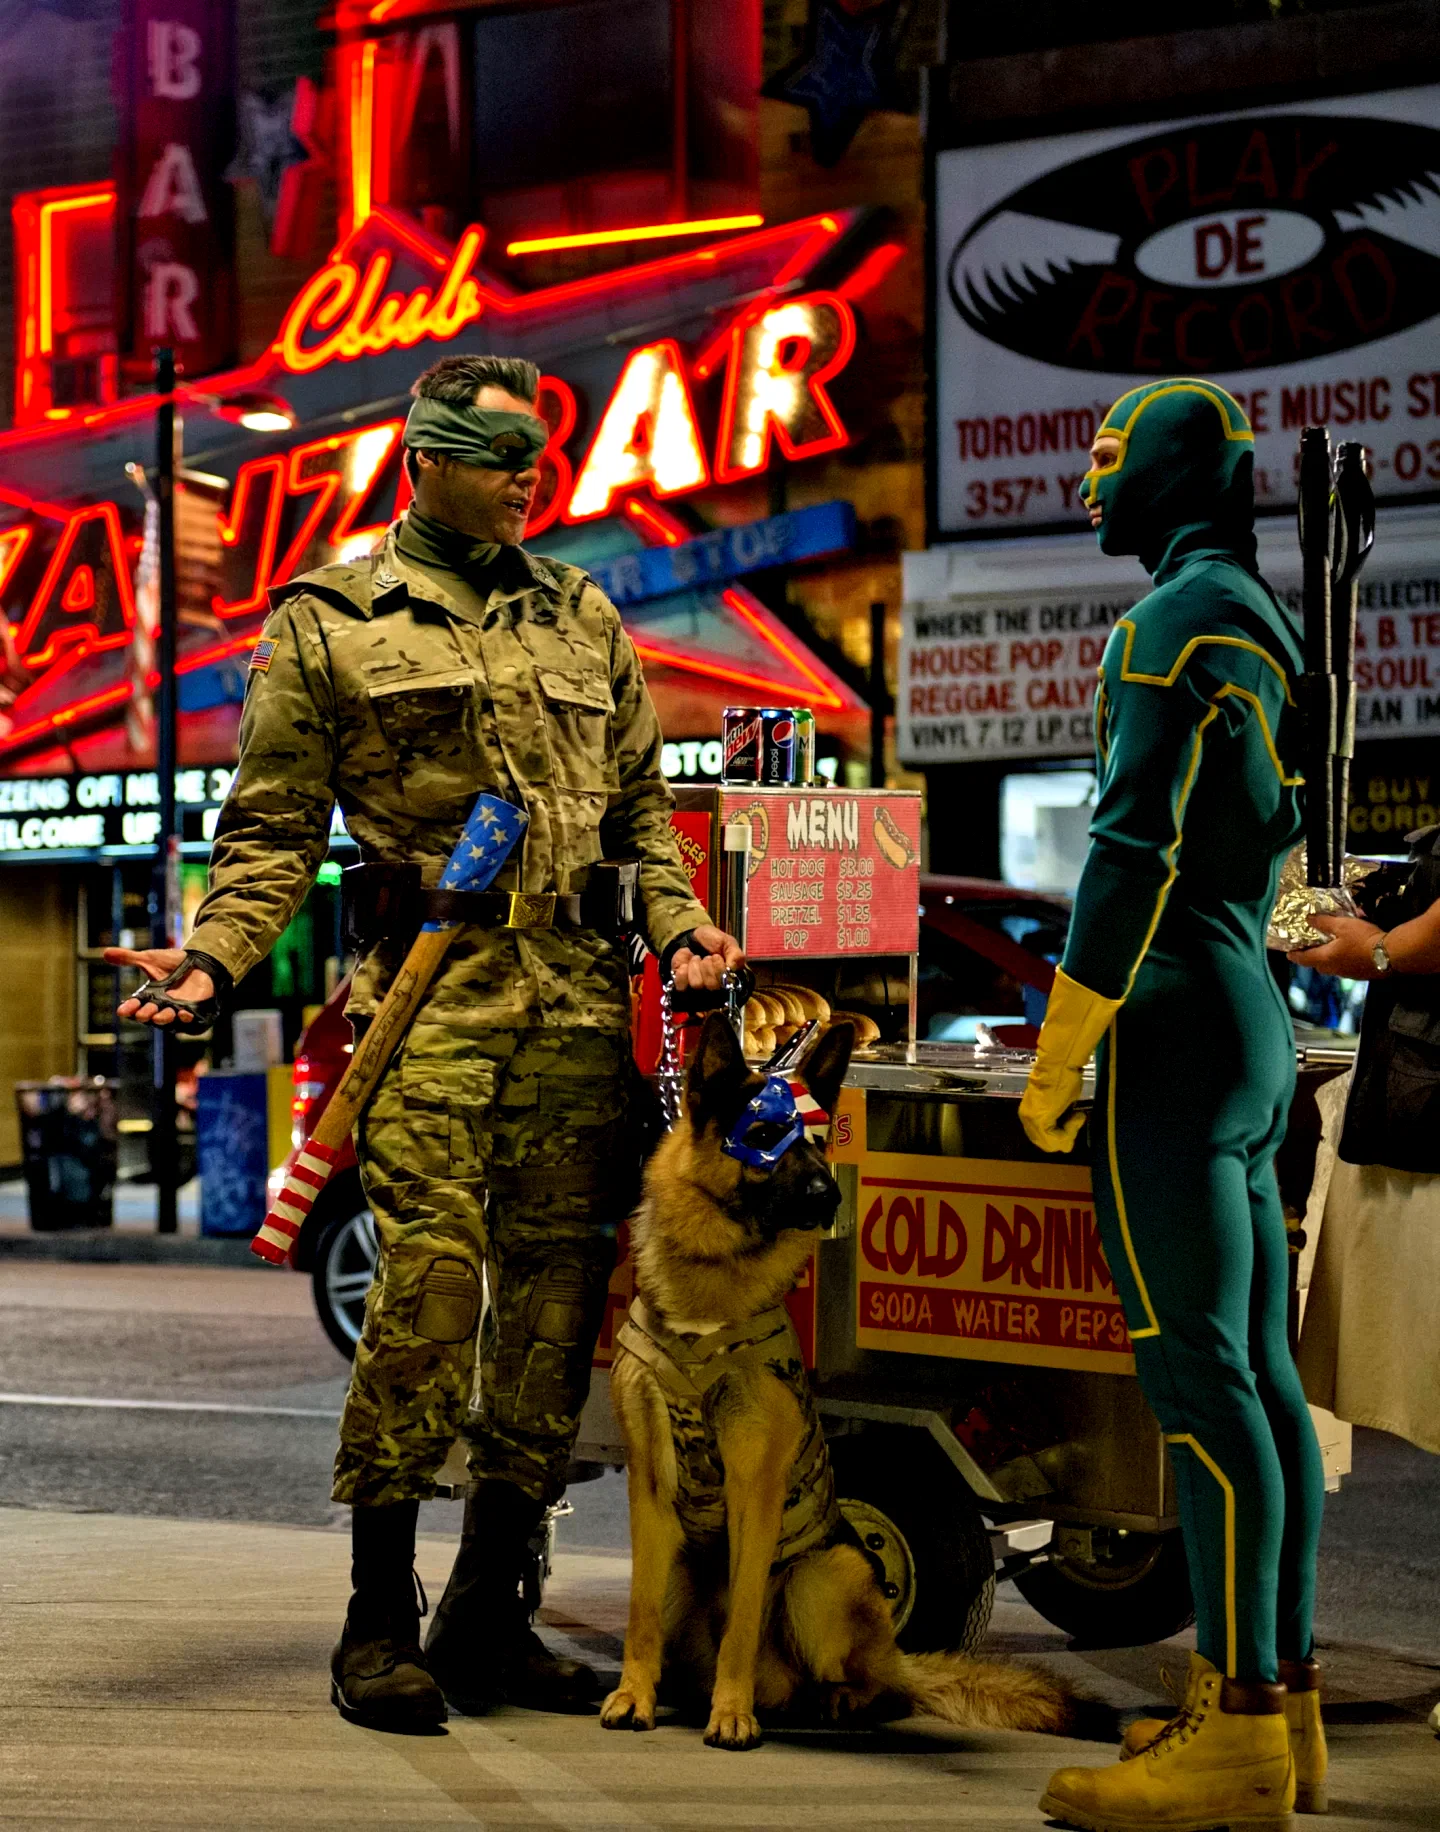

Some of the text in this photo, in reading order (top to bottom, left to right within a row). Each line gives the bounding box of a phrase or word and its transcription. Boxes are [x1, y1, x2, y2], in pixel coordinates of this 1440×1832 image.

[138, 20, 206, 342] BAR
[1127, 128, 1340, 225] PLAY
[1195, 216, 1266, 279] DE
[282, 223, 487, 372] Club
[1066, 236, 1398, 371] RECORD
[1280, 377, 1393, 430] MUSIC
[914, 610, 987, 638] WHERE
[995, 606, 1030, 633] THE
[909, 641, 1000, 679] HOUSE
[1009, 637, 1063, 672] POP
[910, 679, 1017, 717] REGGAE
[910, 721, 968, 748] VINYL
[1037, 714, 1063, 741] LP
[770, 748, 780, 778] pepsi
[1367, 775, 1431, 804] BUY
[787, 799, 860, 852] MENU
[770, 857, 875, 879] HOT DOG $3.00
[769, 880, 873, 902] SAUSAGE $3.25
[771, 904, 872, 926] PRETZEL $1.25
[784, 928, 870, 950] POP $1.00
[861, 1194, 1119, 1298] COLD DRINK
[869, 1289, 1130, 1346] SODA WATER PEPS
